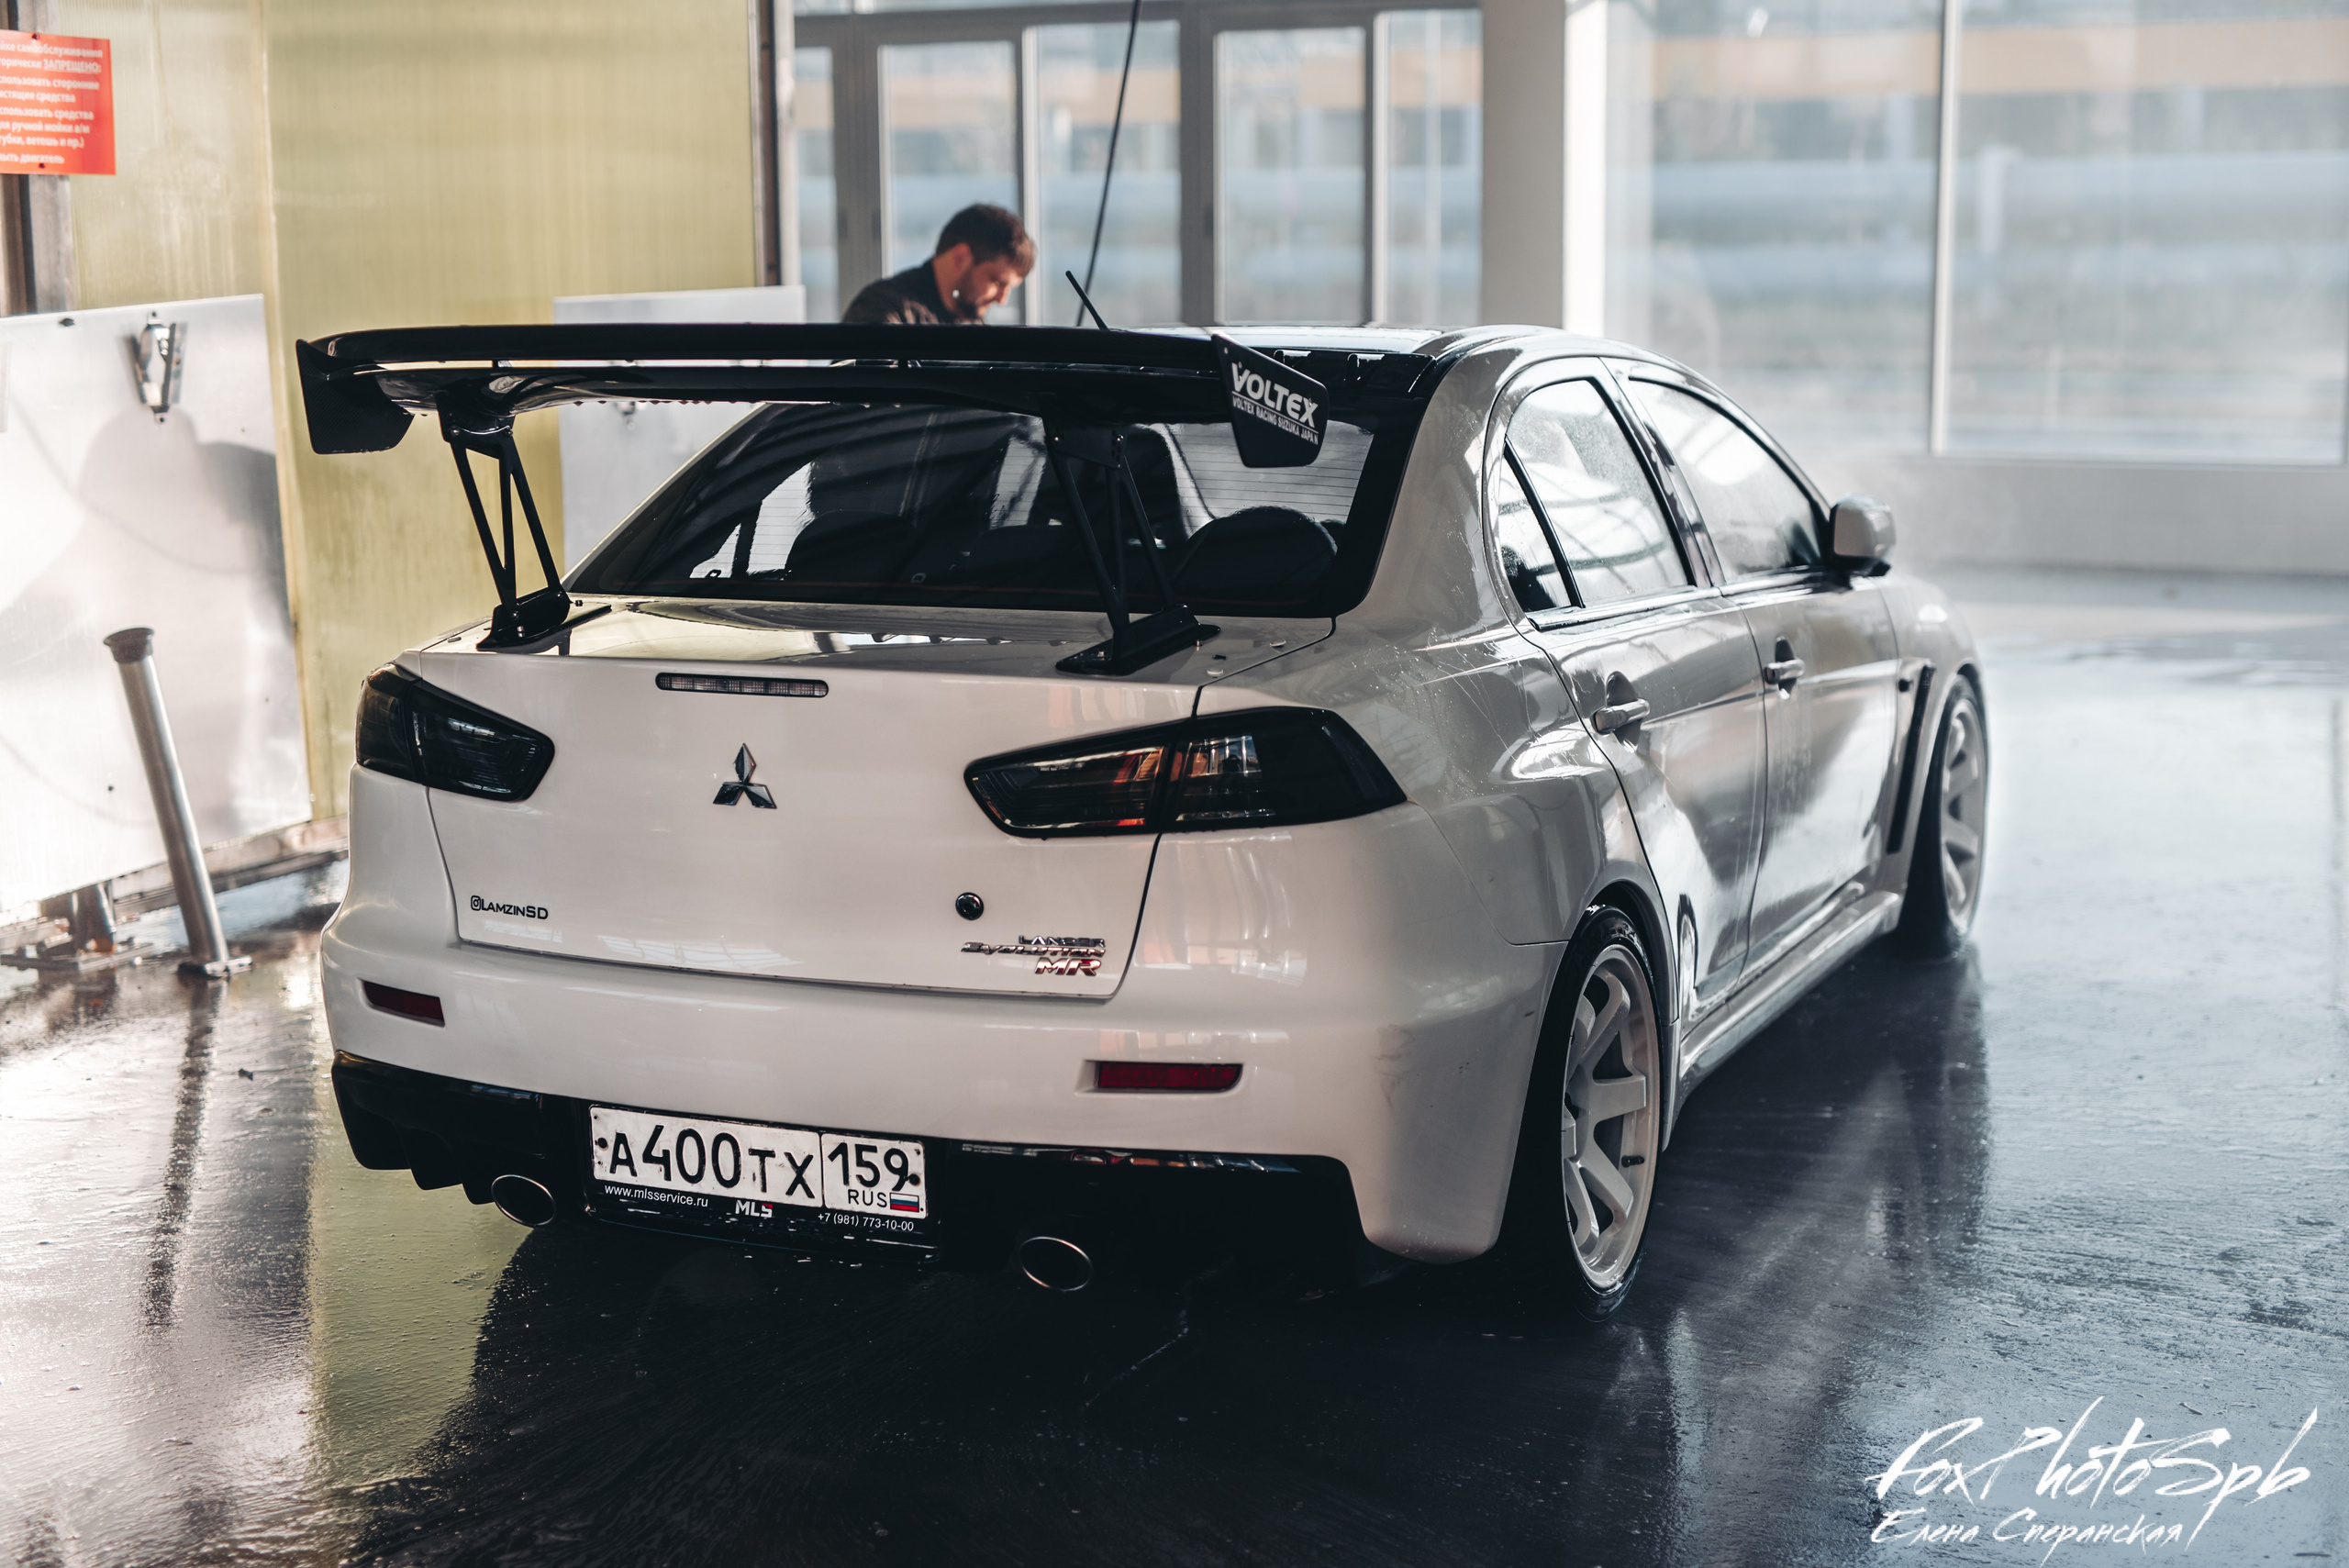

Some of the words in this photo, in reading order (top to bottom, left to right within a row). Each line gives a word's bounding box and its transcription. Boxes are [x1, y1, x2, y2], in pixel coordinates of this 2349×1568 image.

[0, 58, 42, 69] орически
[1231, 362, 1319, 428] VOLTEX
[1232, 395, 1255, 415] VOLTEX
[1256, 406, 1277, 426] RACING
[1277, 416, 1300, 437] SUZUKA
[1034, 957, 1101, 976] MR
[828, 1142, 910, 1192] 159
[604, 1184, 709, 1208] www.mlsservice.ru
[847, 1189, 887, 1208] RUS
[735, 1199, 773, 1218] MLS
[818, 1212, 830, 1223] +7
[833, 1213, 860, 1228] (981)
[863, 1216, 914, 1231] 773-10-00
